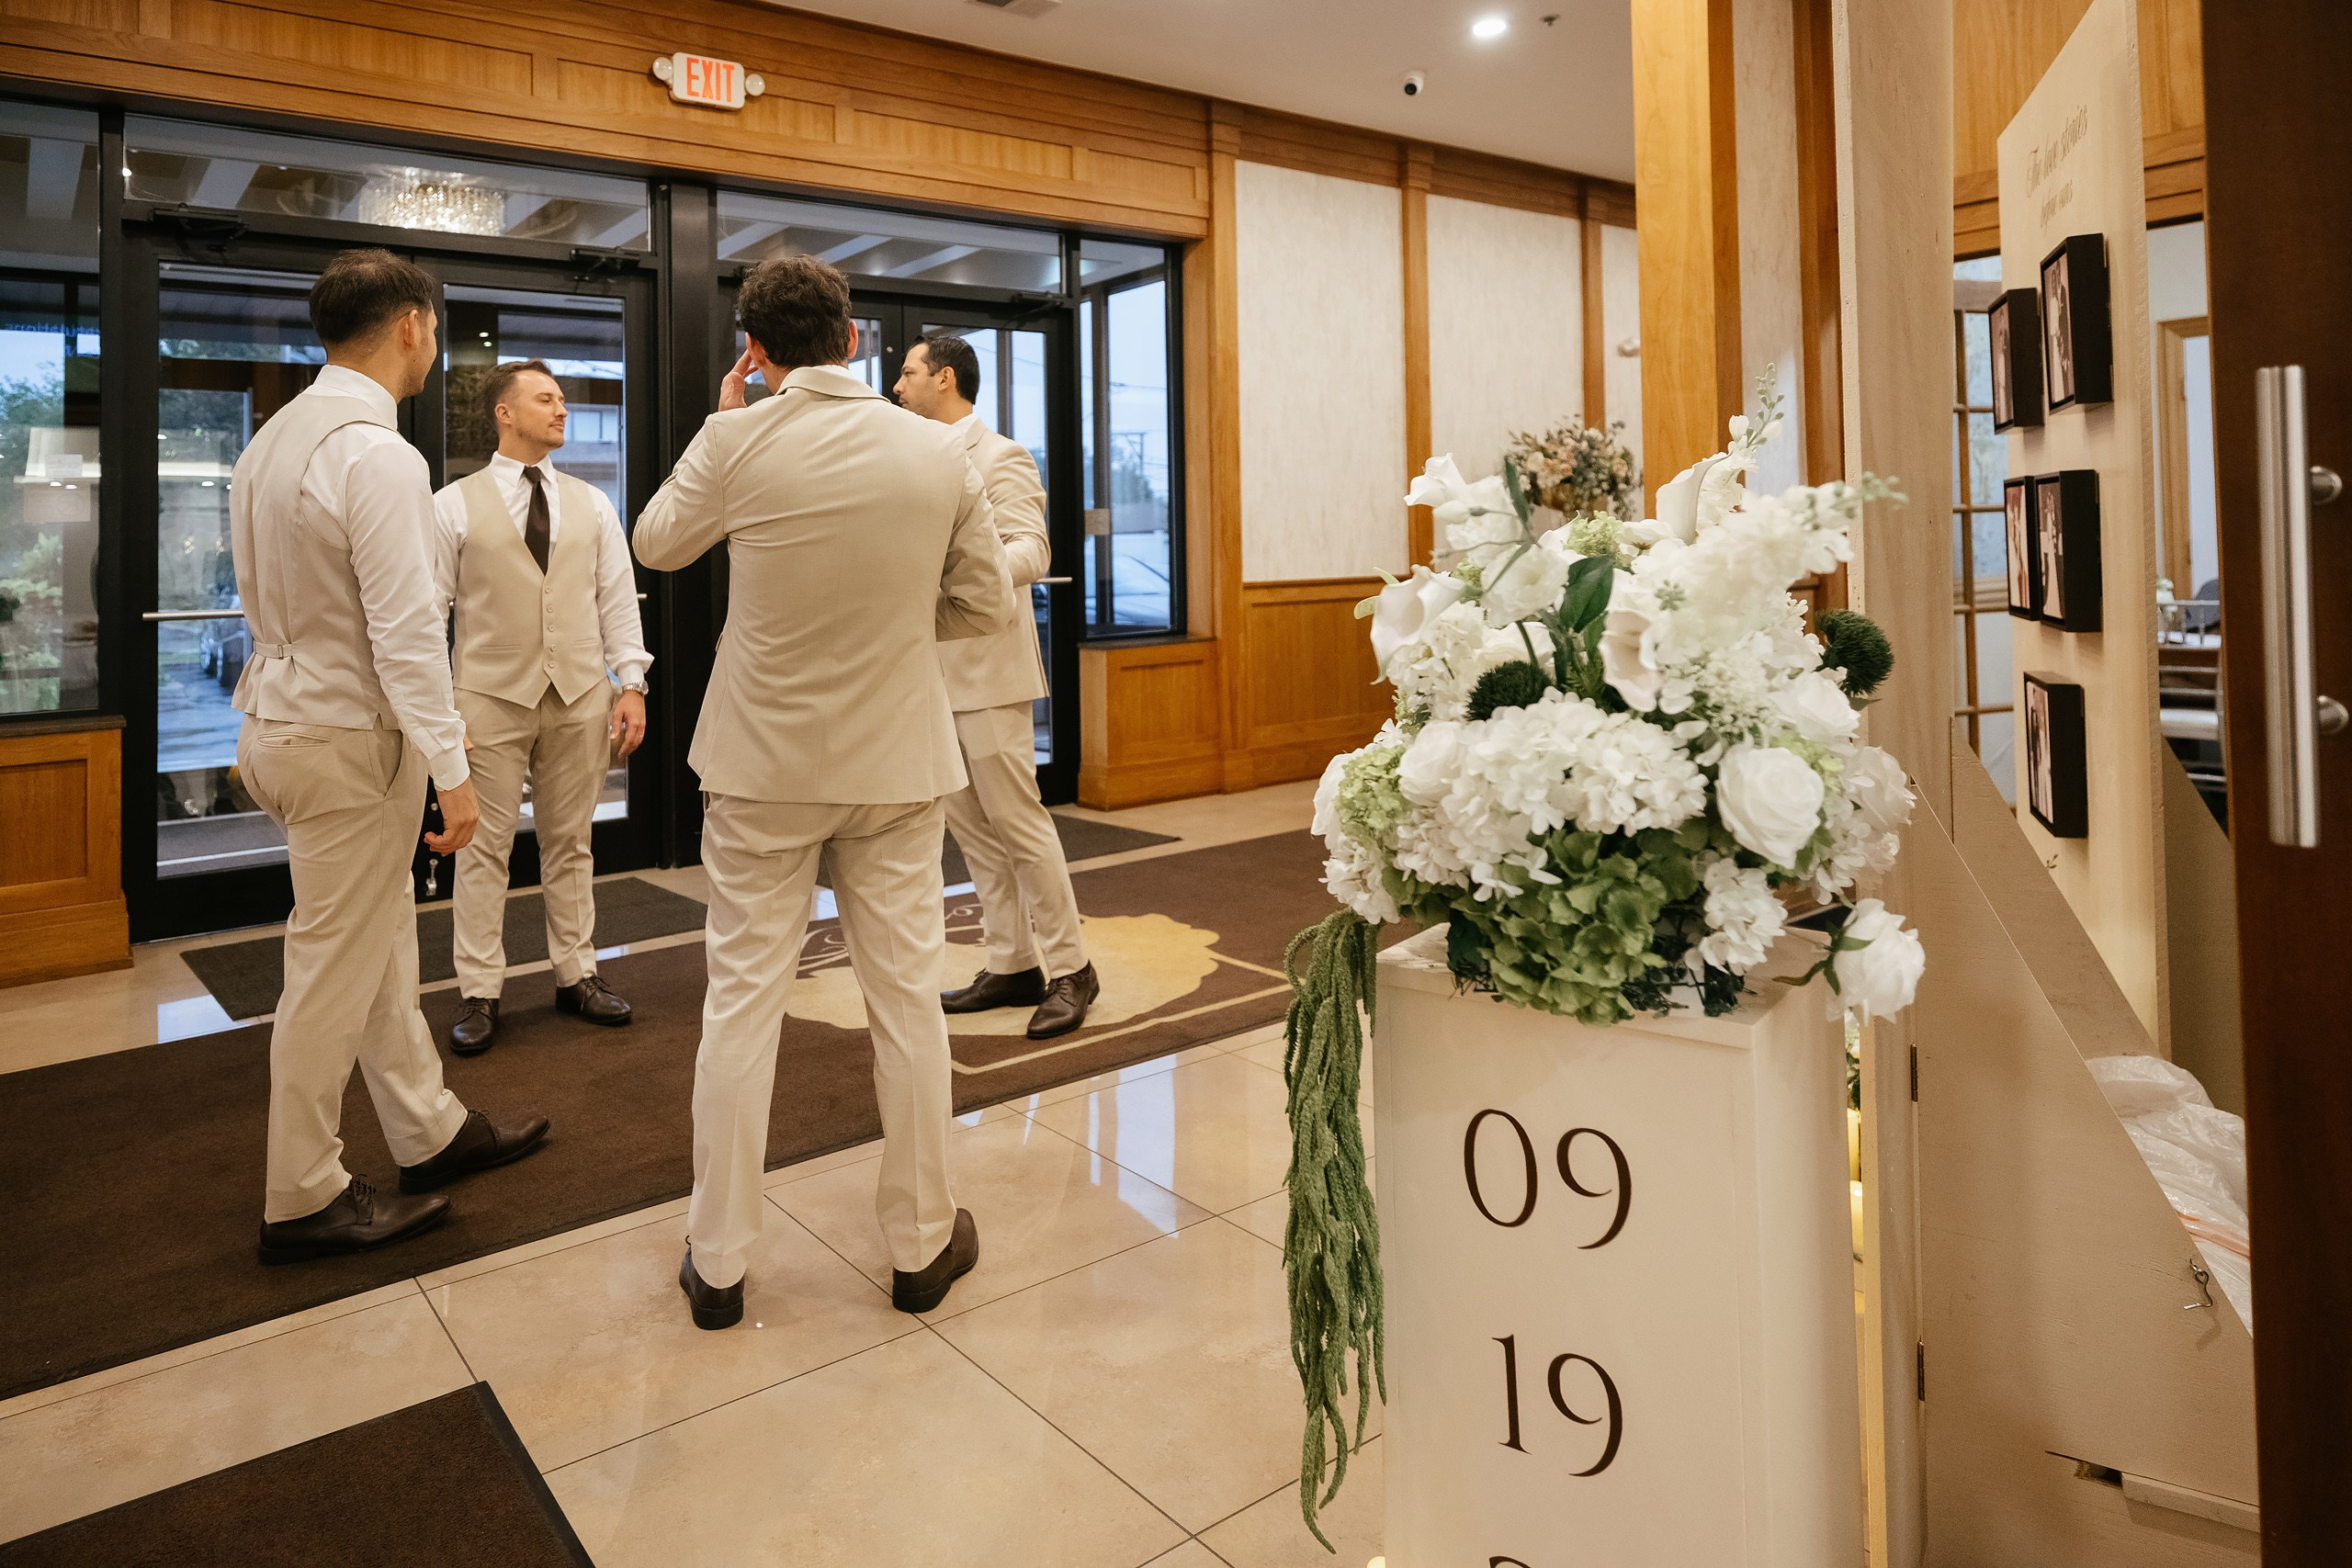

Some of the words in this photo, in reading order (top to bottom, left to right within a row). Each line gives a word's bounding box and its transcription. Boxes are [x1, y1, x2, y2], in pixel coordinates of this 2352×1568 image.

[686, 57, 736, 103] EXIT
[1464, 1108, 1632, 1250] 09
[1491, 1334, 1623, 1478] 19
